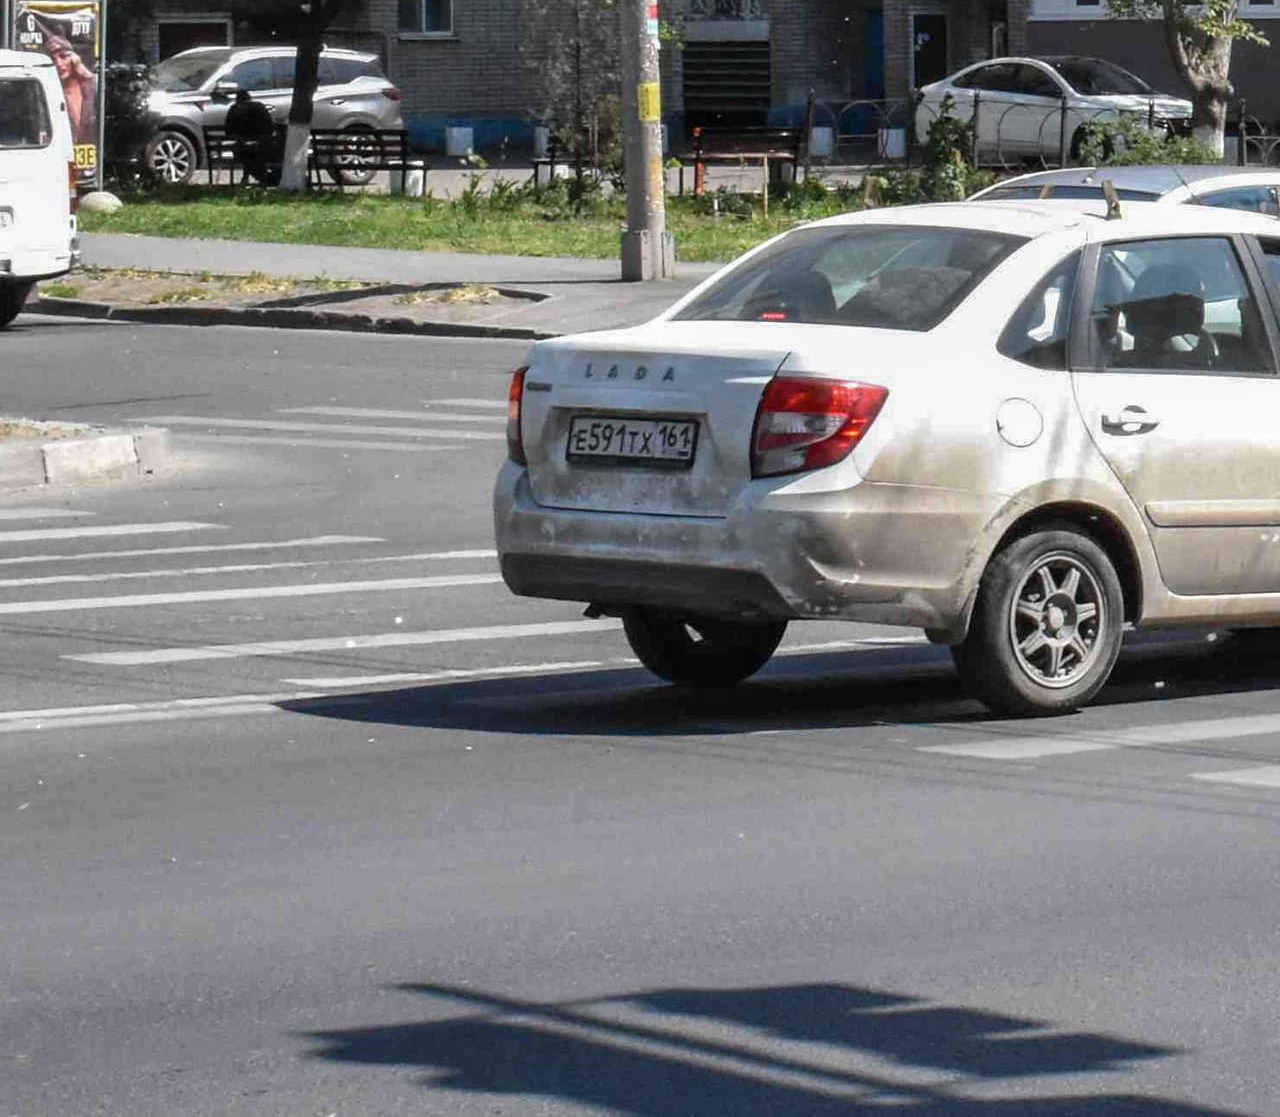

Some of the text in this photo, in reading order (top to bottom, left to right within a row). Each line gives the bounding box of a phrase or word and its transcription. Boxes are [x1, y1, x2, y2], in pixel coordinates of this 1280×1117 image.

[585, 363, 676, 382] LADA
[575, 422, 691, 454] Е591ТХ 161
